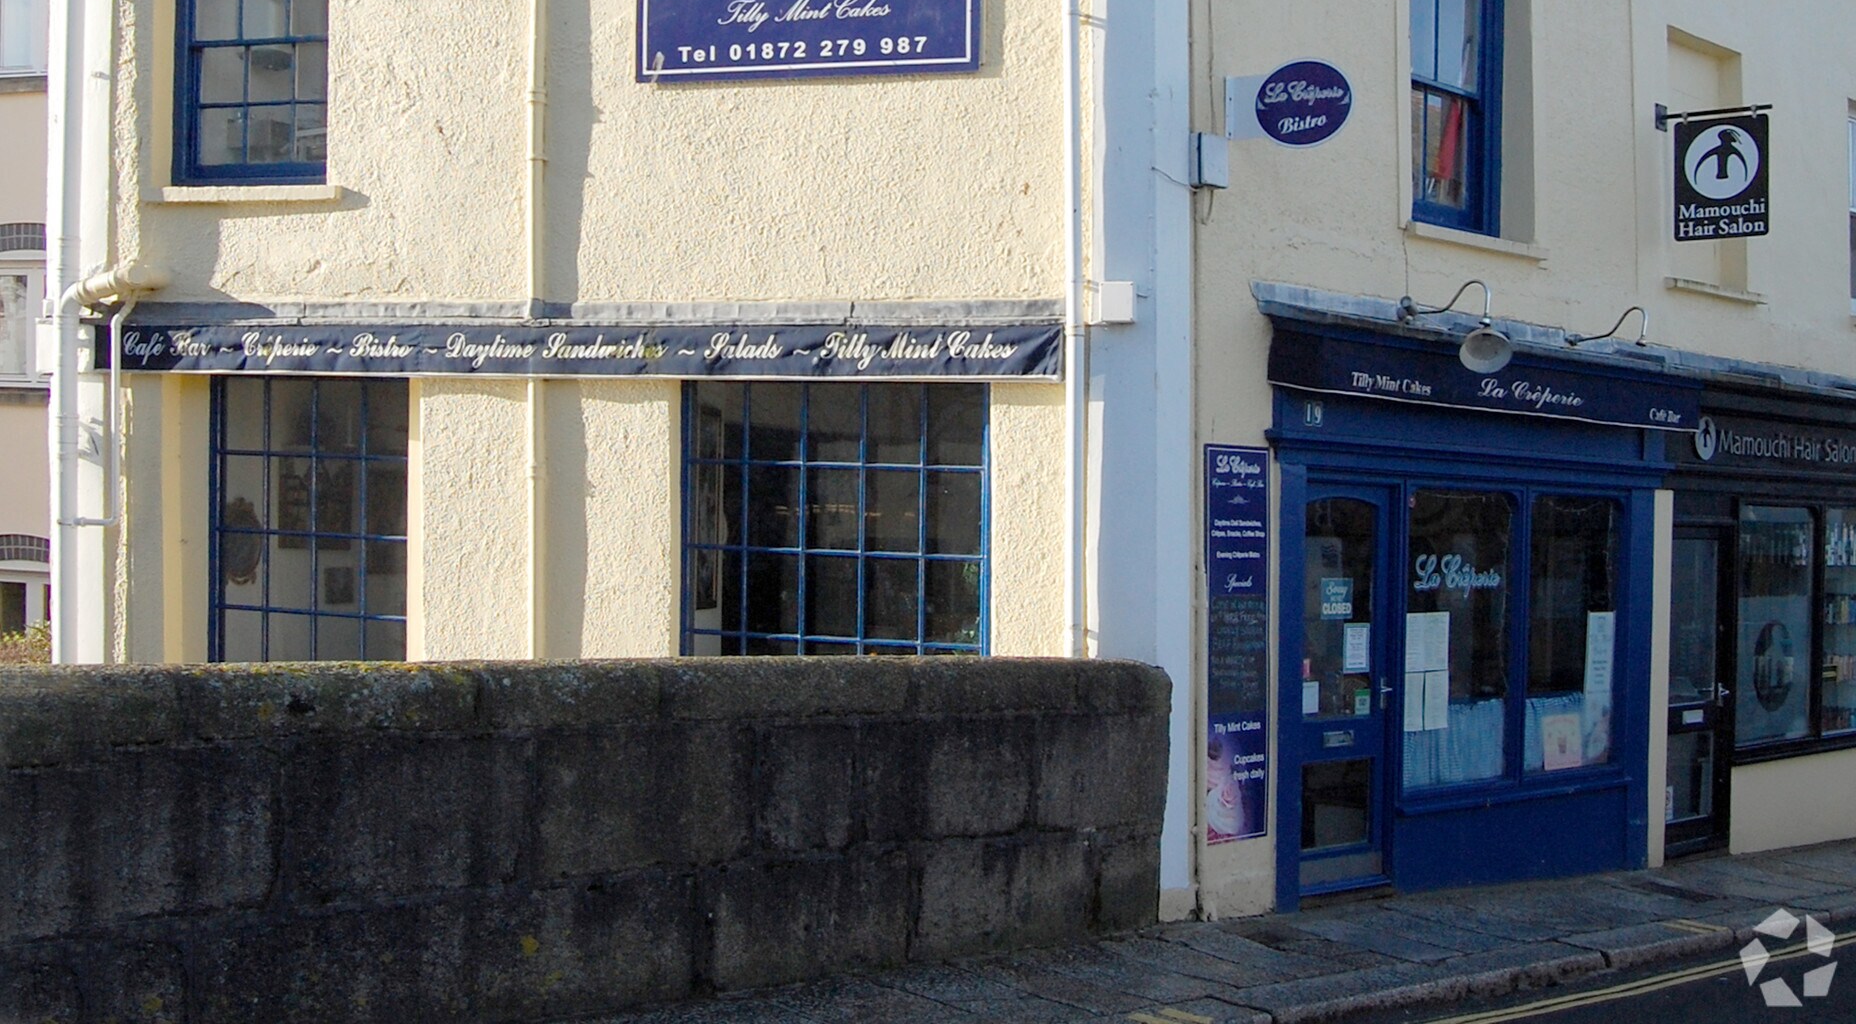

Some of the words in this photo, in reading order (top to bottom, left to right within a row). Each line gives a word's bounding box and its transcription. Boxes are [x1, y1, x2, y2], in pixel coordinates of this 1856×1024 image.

[678, 46, 716, 63] Tel
[729, 42, 807, 60] 01872
[819, 39, 866, 57] 279
[880, 36, 928, 54] 987
[1264, 82, 1289, 103] La
[1278, 115, 1327, 135] Bistro
[1679, 198, 1766, 220] Mamouchi
[1679, 220, 1716, 237] Hair
[1718, 217, 1765, 235] Salon
[123, 331, 164, 365] Café
[170, 332, 210, 356] Bar
[241, 331, 319, 366] Crêperie
[350, 332, 412, 358] Bistro
[445, 333, 536, 368] Daytime
[542, 332, 668, 359] Sandwiches
[704, 332, 783, 360] Salads
[818, 333, 881, 370] Tilly
[881, 332, 940, 360] Mint
[945, 331, 1017, 359] Cakes
[1352, 371, 1374, 391] Tilly
[1375, 374, 1400, 392] Mint
[1402, 379, 1432, 396] Cakes
[1478, 378, 1507, 398] La
[1511, 381, 1584, 409] Crêperie
[1305, 402, 1322, 424] 19
[1719, 429, 1790, 458] Mamouchi
[1794, 436, 1820, 462] Hair
[1824, 439, 1856, 464] Salon
[1413, 553, 1441, 589] La
[1440, 553, 1501, 598] Crêperie
[1322, 602, 1352, 615] CLOSED
[1214, 723, 1226, 735] Tilly
[1227, 722, 1240, 733] Mint
[1241, 721, 1261, 731] Cakes
[1233, 753, 1265, 766] Cupcakes
[1250, 768, 1265, 779] daily
